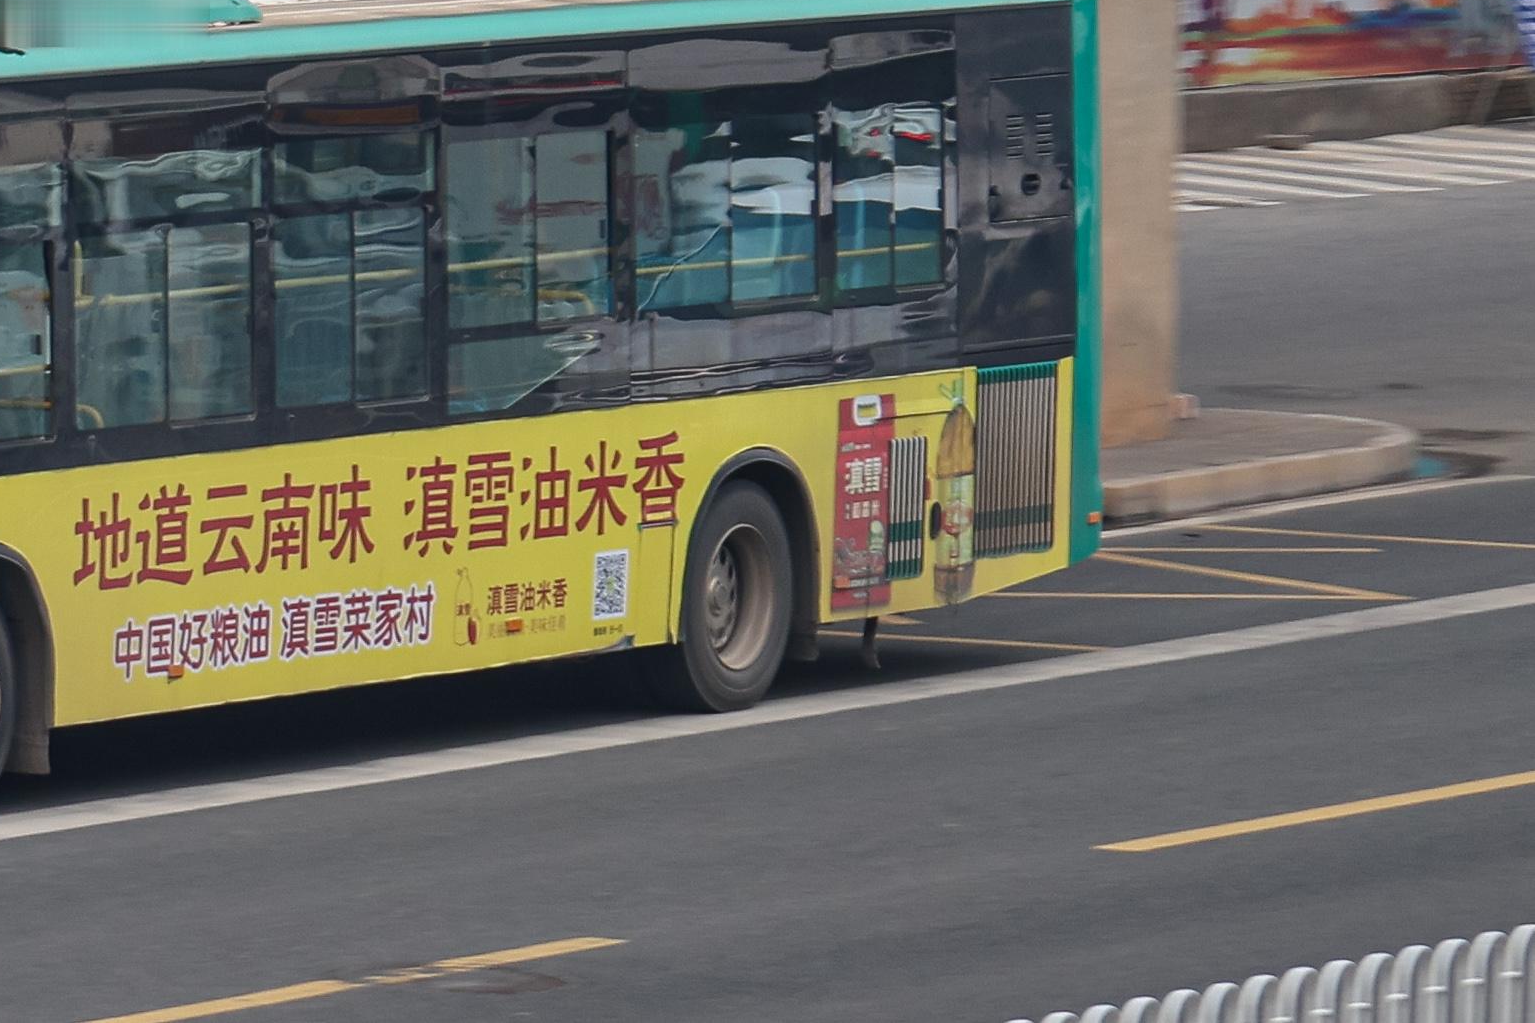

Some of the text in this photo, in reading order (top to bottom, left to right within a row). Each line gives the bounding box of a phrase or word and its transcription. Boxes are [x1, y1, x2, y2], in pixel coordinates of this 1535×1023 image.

[72, 430, 686, 592] 地道云南味 滇雪油米香
[114, 583, 433, 680] 中国好粮油 滇雪菜家村
[487, 578, 568, 615] 滇雪油米香
